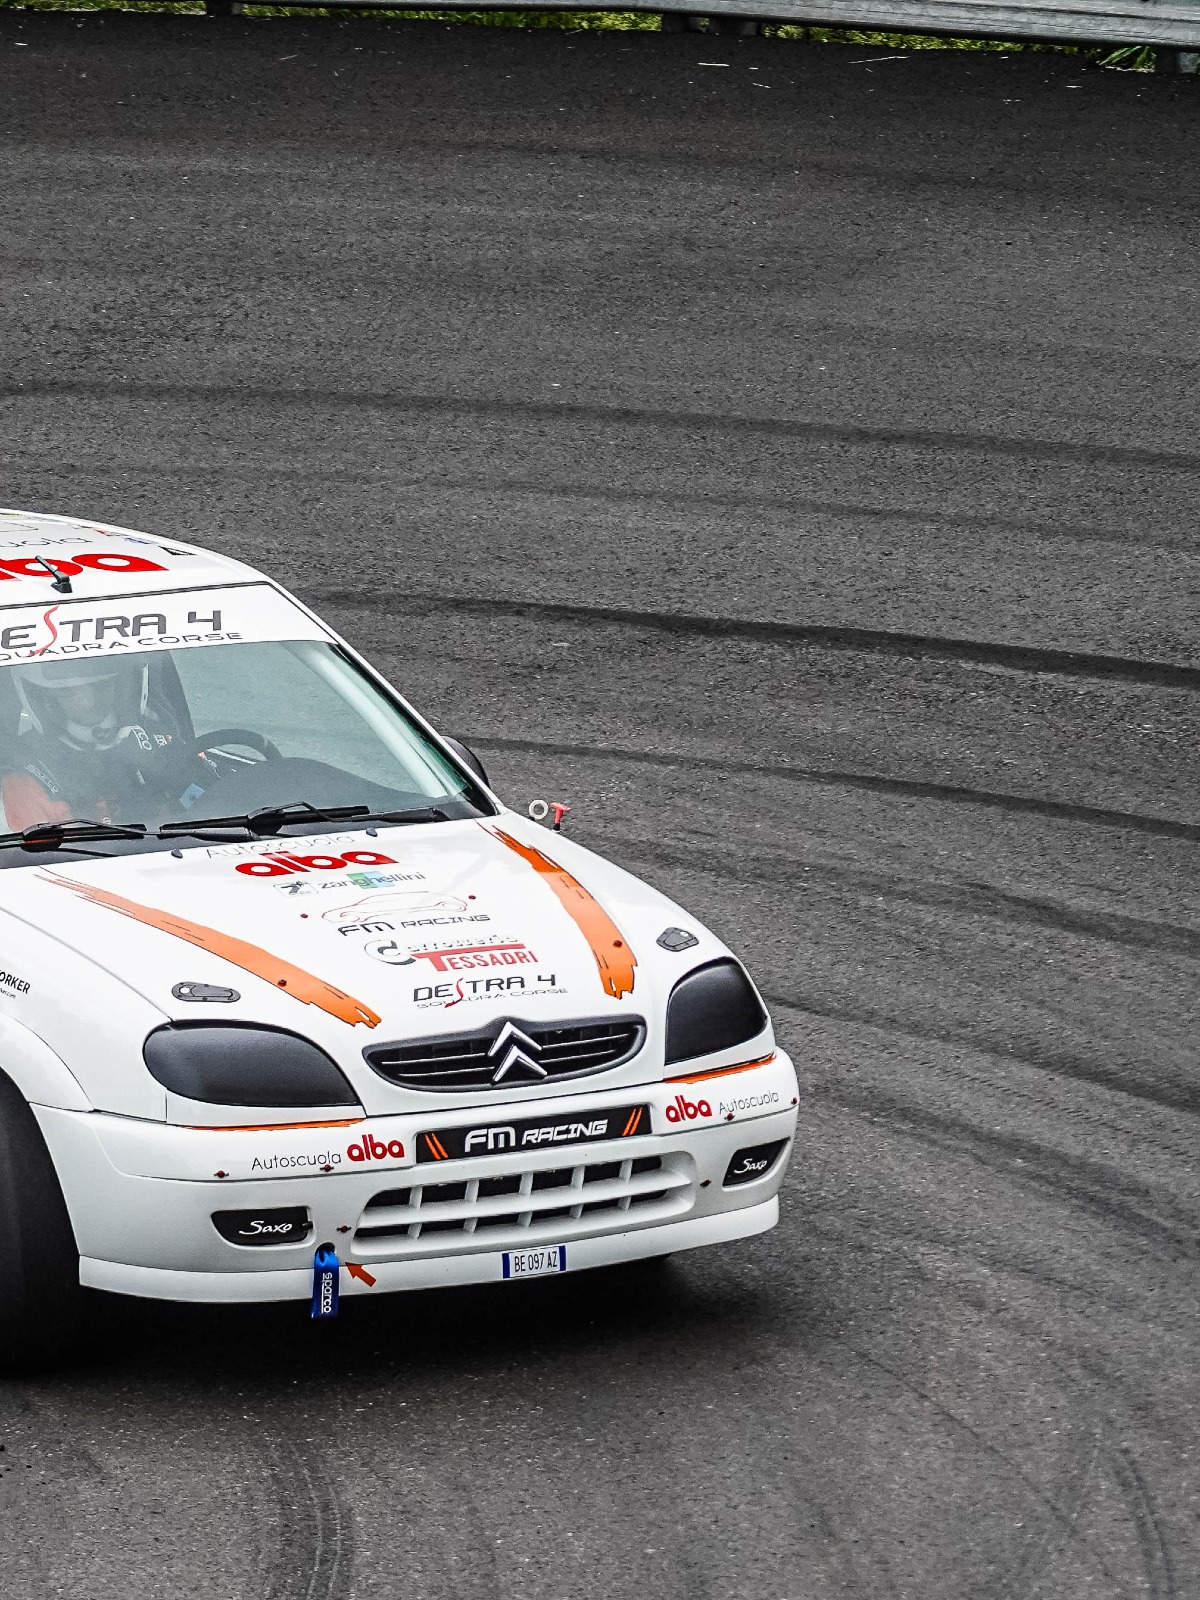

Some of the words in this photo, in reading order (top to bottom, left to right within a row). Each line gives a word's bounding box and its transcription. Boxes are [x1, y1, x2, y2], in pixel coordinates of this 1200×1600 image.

[187, 609, 222, 632] 4
[138, 631, 243, 647] CORSE
[206, 834, 356, 859] Autoscuola
[235, 850, 400, 877] alba
[318, 872, 426, 889] zanghellini
[338, 920, 395, 936] FM
[401, 914, 491, 929] RACING
[410, 943, 539, 972] TESSADRI
[413, 977, 525, 1006] DESTRA
[537, 974, 556, 986] 4
[510, 987, 569, 998] CORSE
[665, 1094, 713, 1122] alba
[719, 1090, 780, 1115] Autoscuola
[465, 1125, 516, 1153] FM
[522, 1119, 608, 1146] RACING
[251, 1150, 342, 1171] Autoscuola
[346, 1134, 405, 1162] alba
[734, 1157, 768, 1174] Saxo
[238, 1220, 293, 1235] Saxo
[514, 1255, 526, 1272] BE
[528, 1252, 544, 1270] 097
[547, 1251, 557, 1268] AZ
[321, 1272, 332, 1314] sparco
